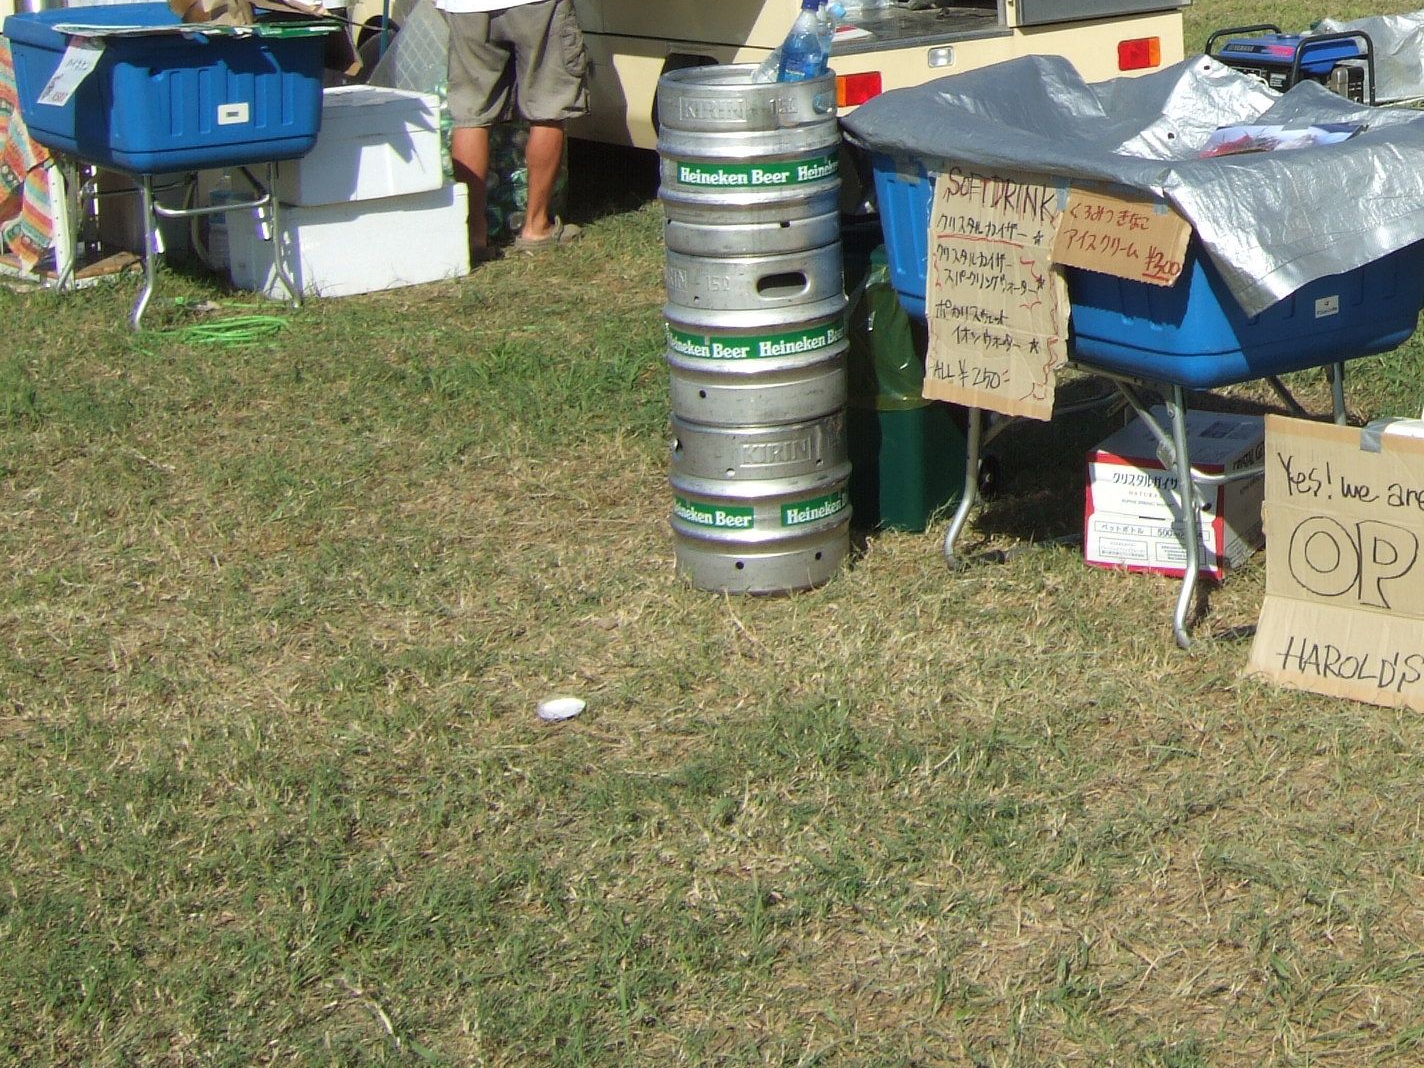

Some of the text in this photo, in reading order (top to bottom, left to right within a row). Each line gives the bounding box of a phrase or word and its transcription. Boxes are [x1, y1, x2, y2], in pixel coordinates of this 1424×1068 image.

[679, 166, 748, 185] Heineken
[751, 168, 791, 185] Beer
[712, 342, 751, 359] Beer
[758, 334, 827, 358] Heineken
[1340, 476, 1380, 504] we
[715, 510, 753, 528] Beer
[1275, 636, 1424, 693] HAROLD'S
